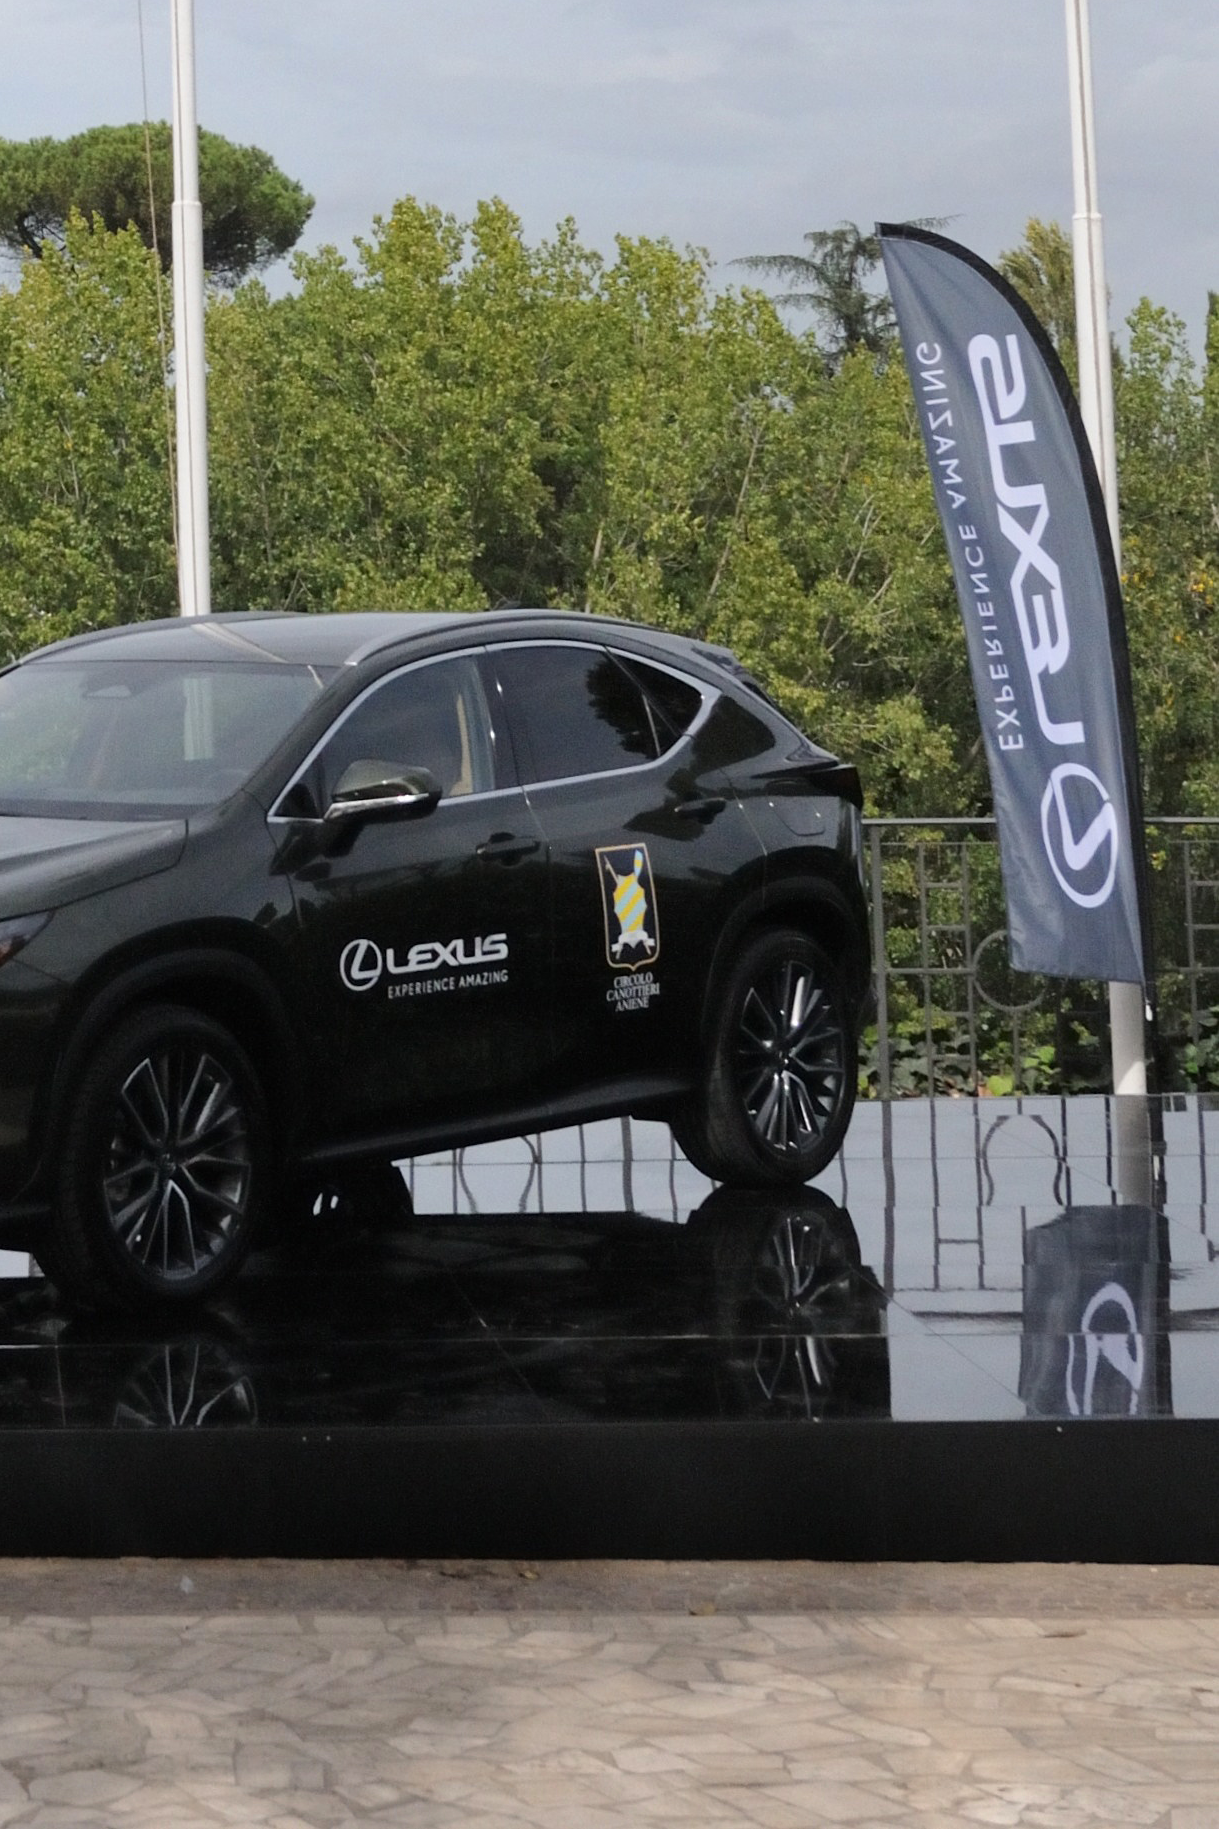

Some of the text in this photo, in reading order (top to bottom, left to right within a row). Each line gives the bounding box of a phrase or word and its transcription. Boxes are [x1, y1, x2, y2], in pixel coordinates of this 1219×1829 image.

[386, 932, 509, 974] LEXUS
[387, 969, 509, 1000] EXPERIENCE AMAZING
[613, 971, 654, 989] CIRCOLO
[606, 982, 661, 1002] CANOTTIERI
[614, 995, 651, 1012] ANIENE
